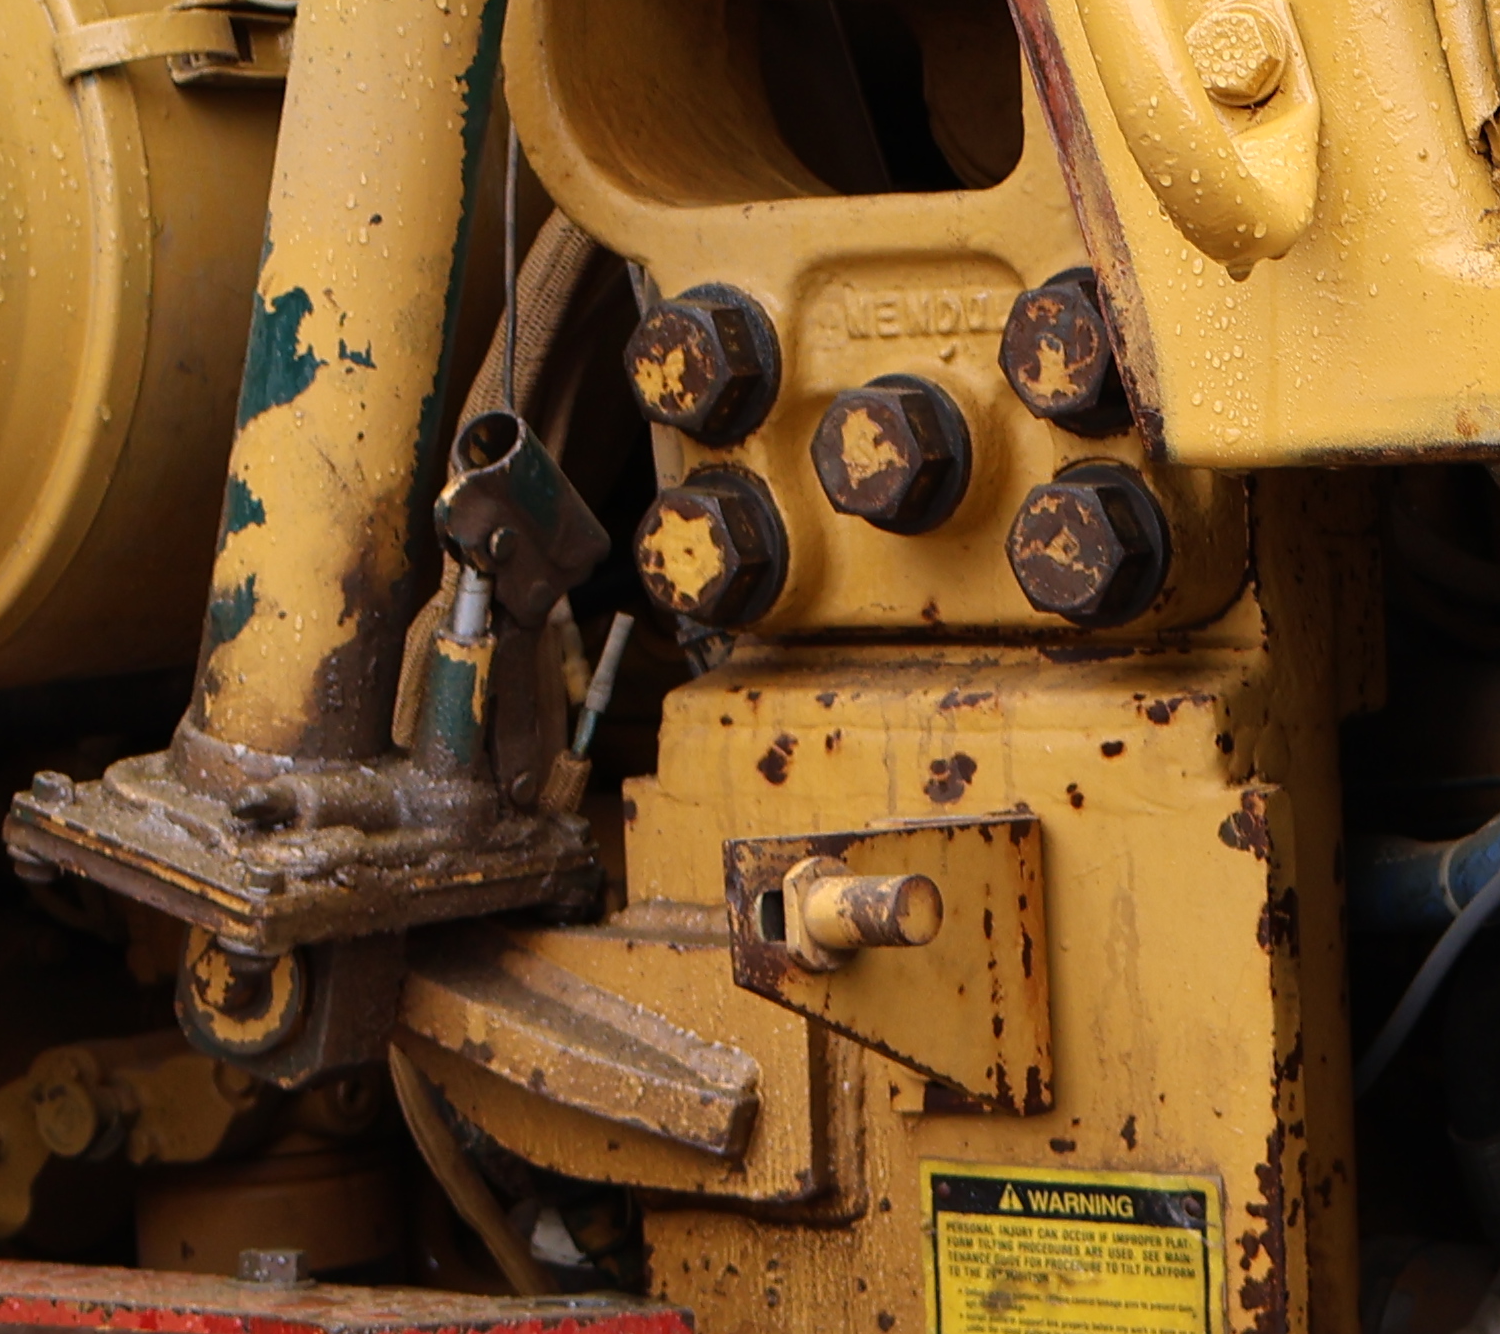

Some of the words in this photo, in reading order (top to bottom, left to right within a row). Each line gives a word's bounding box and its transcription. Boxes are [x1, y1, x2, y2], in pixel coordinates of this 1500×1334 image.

[1027, 1188, 1135, 1218] WARNING
[946, 1221, 993, 1235] PERSONAL
[999, 1224, 1033, 1237] INJURY
[1038, 1227, 1057, 1239] CAN
[1062, 1229, 1095, 1241] OCCUR
[1113, 1232, 1161, 1247] IMPROPER
[1165, 1235, 1192, 1249] PLAT-
[947, 1235, 973, 1247] FORM
[979, 1237, 1013, 1251] TILTING
[1018, 1241, 1081, 1256] PROCEDURES
[1085, 1246, 1102, 1258] ARE
[1142, 1249, 1159, 1262] SEE
[1165, 1251, 1194, 1264] MAIN-
[948, 1249, 990, 1264] TENANCE
[1025, 1256, 1041, 1267] FOR
[1045, 1257, 1102, 1273] PROCEDURE
[1106, 1261, 1118, 1275] TO
[1121, 1262, 1141, 1275] TILT
[1144, 1264, 1196, 1278] PLATFORM
[949, 1264, 960, 1277] TO
[964, 1265, 980, 1278] THE
